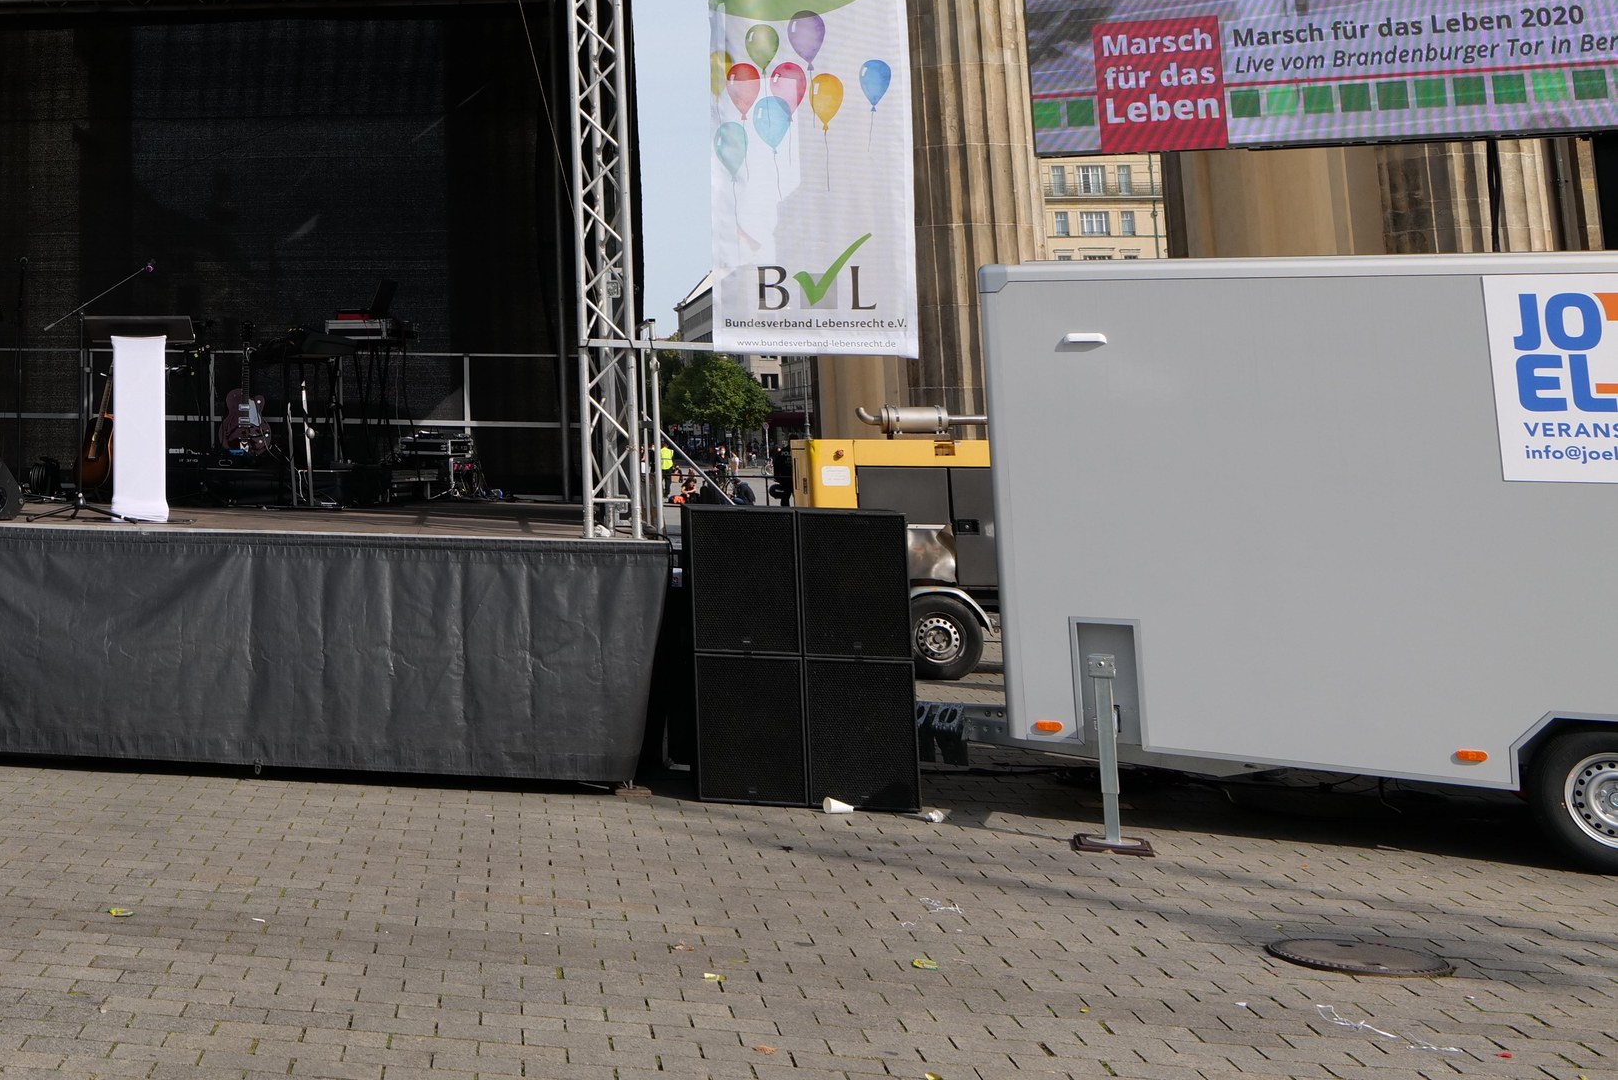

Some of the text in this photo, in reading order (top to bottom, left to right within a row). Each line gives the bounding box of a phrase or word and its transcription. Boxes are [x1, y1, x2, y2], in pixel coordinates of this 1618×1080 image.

[1233, 4, 1584, 47] Marsch für das Leben 2020
[1102, 28, 1212, 57] Marsch
[1235, 55, 1274, 74] Live
[1281, 54, 1325, 71] vom
[1333, 38, 1498, 68] Brandenburger
[1507, 37, 1544, 57] Tor
[1551, 35, 1572, 55] in
[1104, 62, 1216, 90] für das
[1106, 93, 1220, 124] Leben
[725, 318, 907, 328] Bundesverband Lebensrecht e.V.
[737, 339, 896, 348] www.bundesverband-lebensrecht.de
